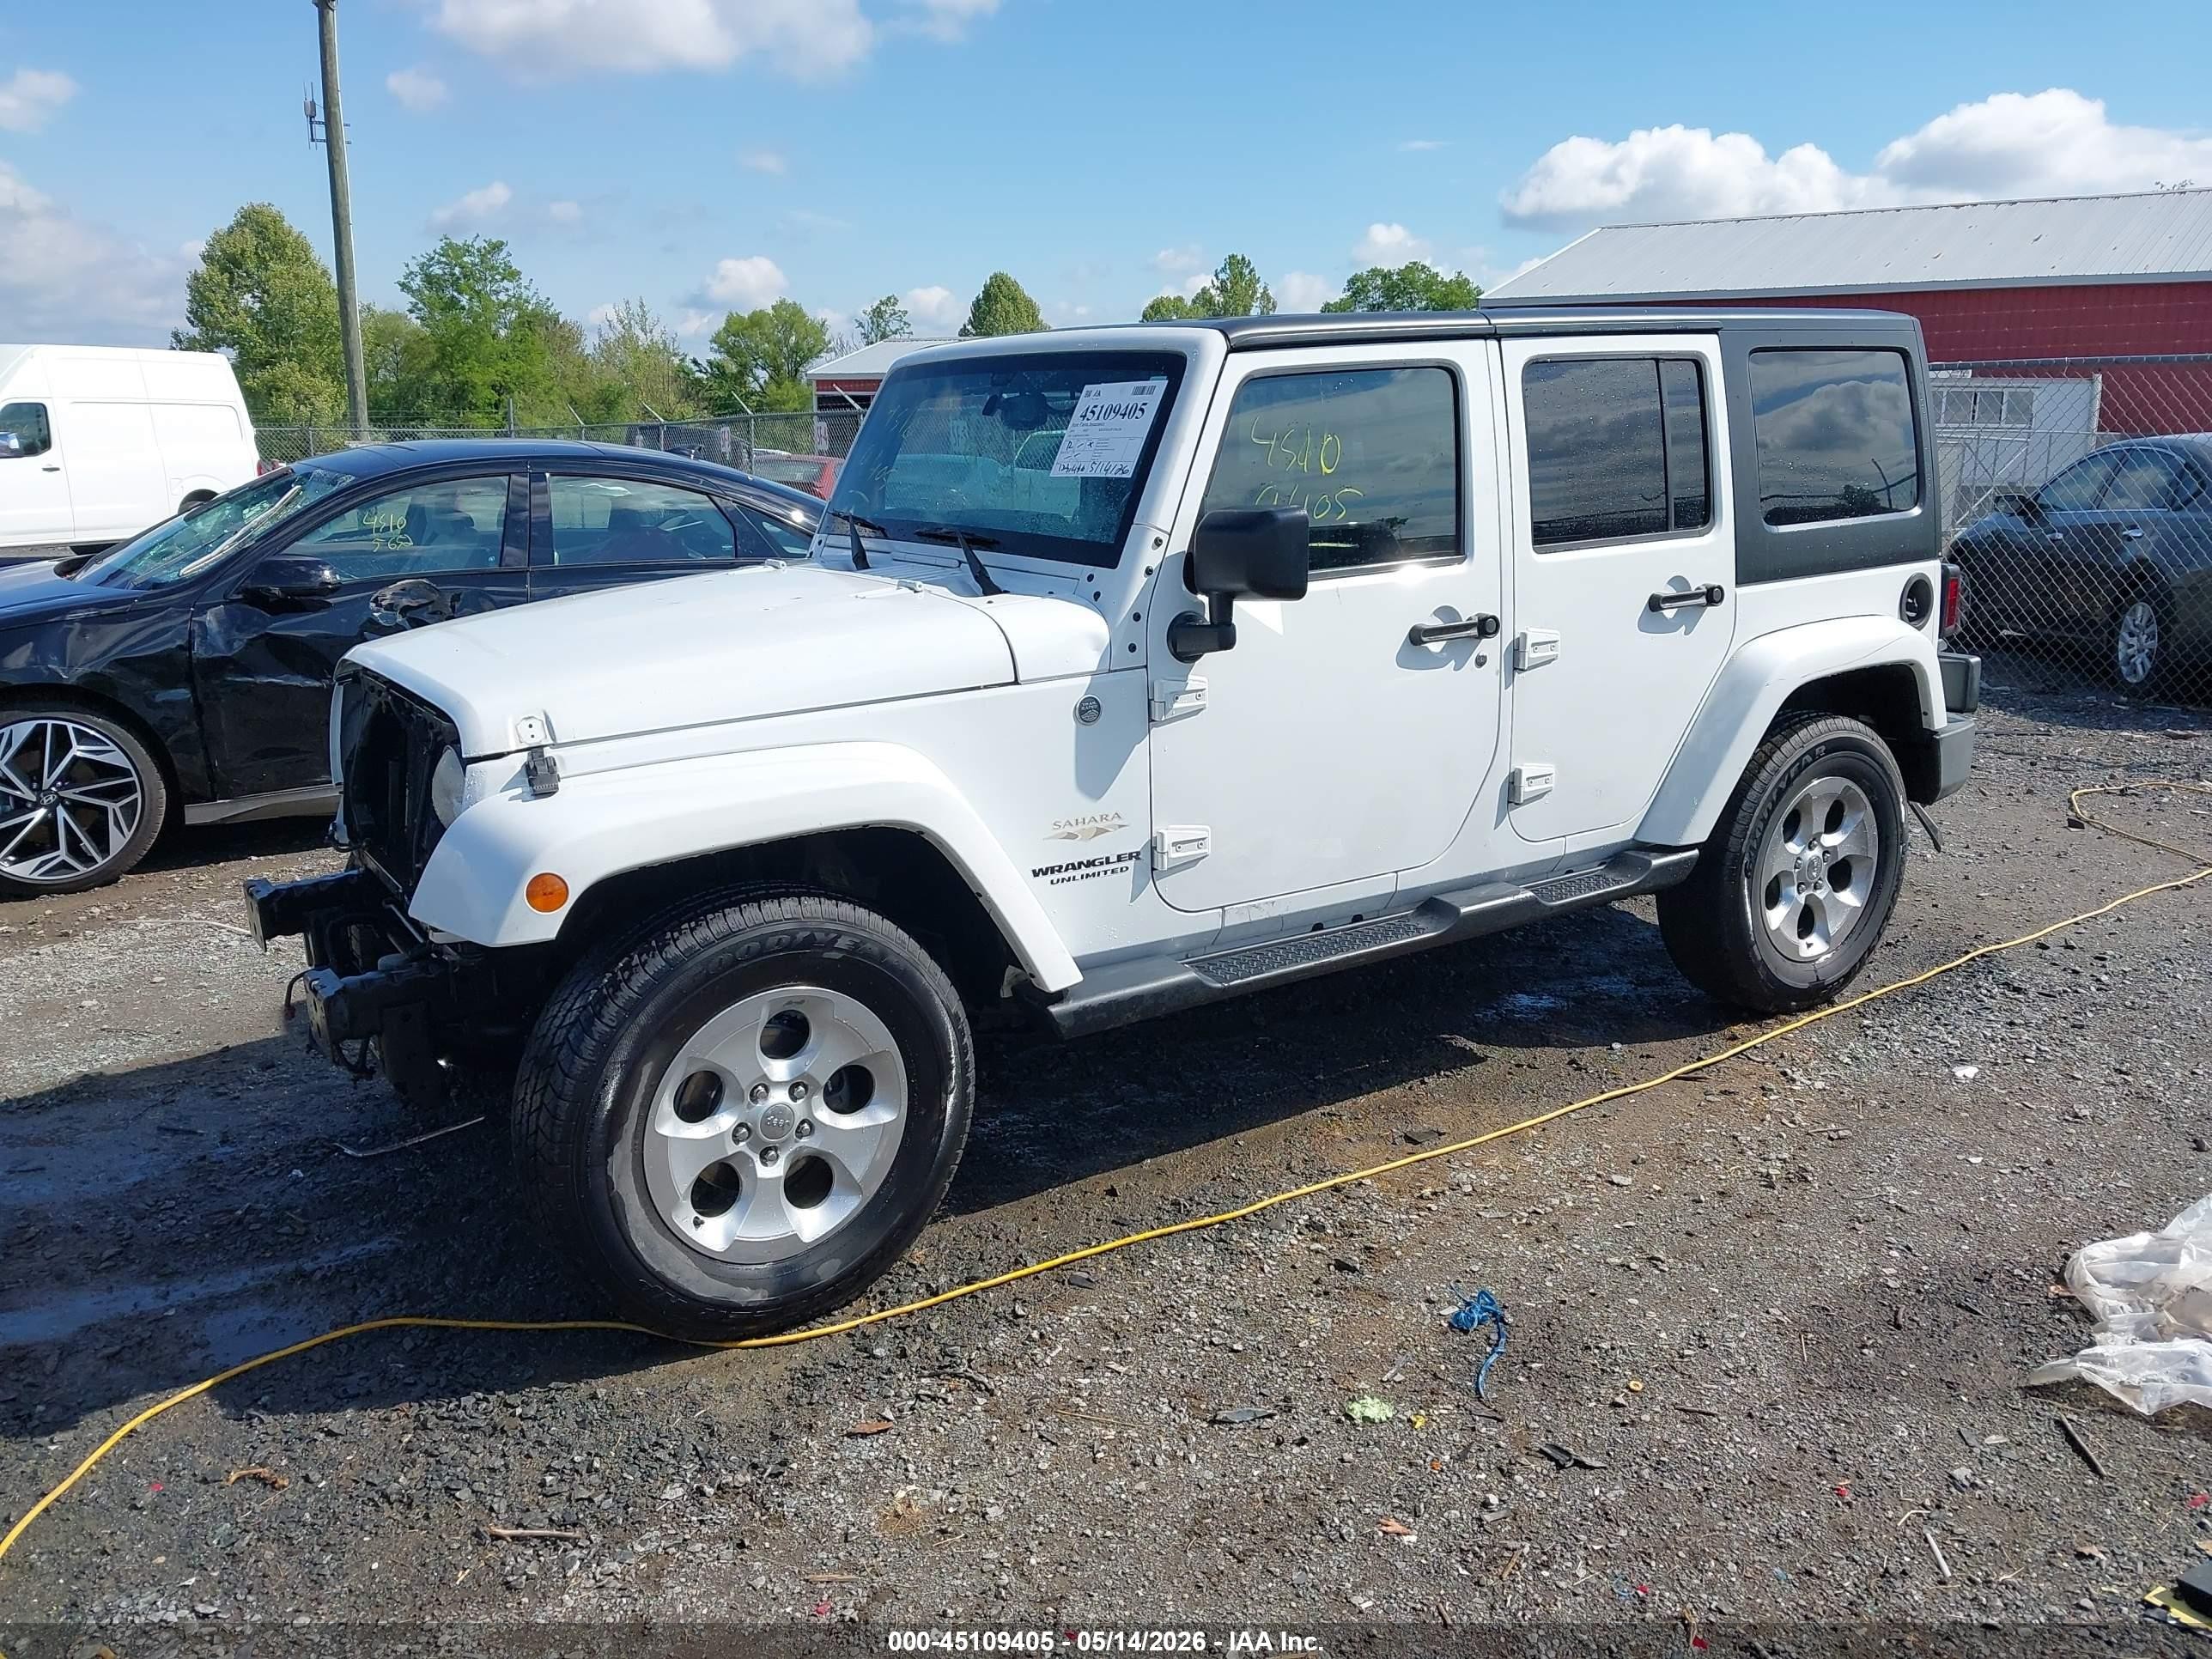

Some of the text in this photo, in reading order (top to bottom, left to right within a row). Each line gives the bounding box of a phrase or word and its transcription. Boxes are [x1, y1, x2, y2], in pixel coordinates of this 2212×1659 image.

[1079, 403, 1148, 422] 45109405
[362, 511, 407, 535] 4510
[1052, 811, 1122, 830] SAHARA
[1031, 850, 1142, 878] WRANGLER
[1050, 866, 1130, 885] UNLIMITED
